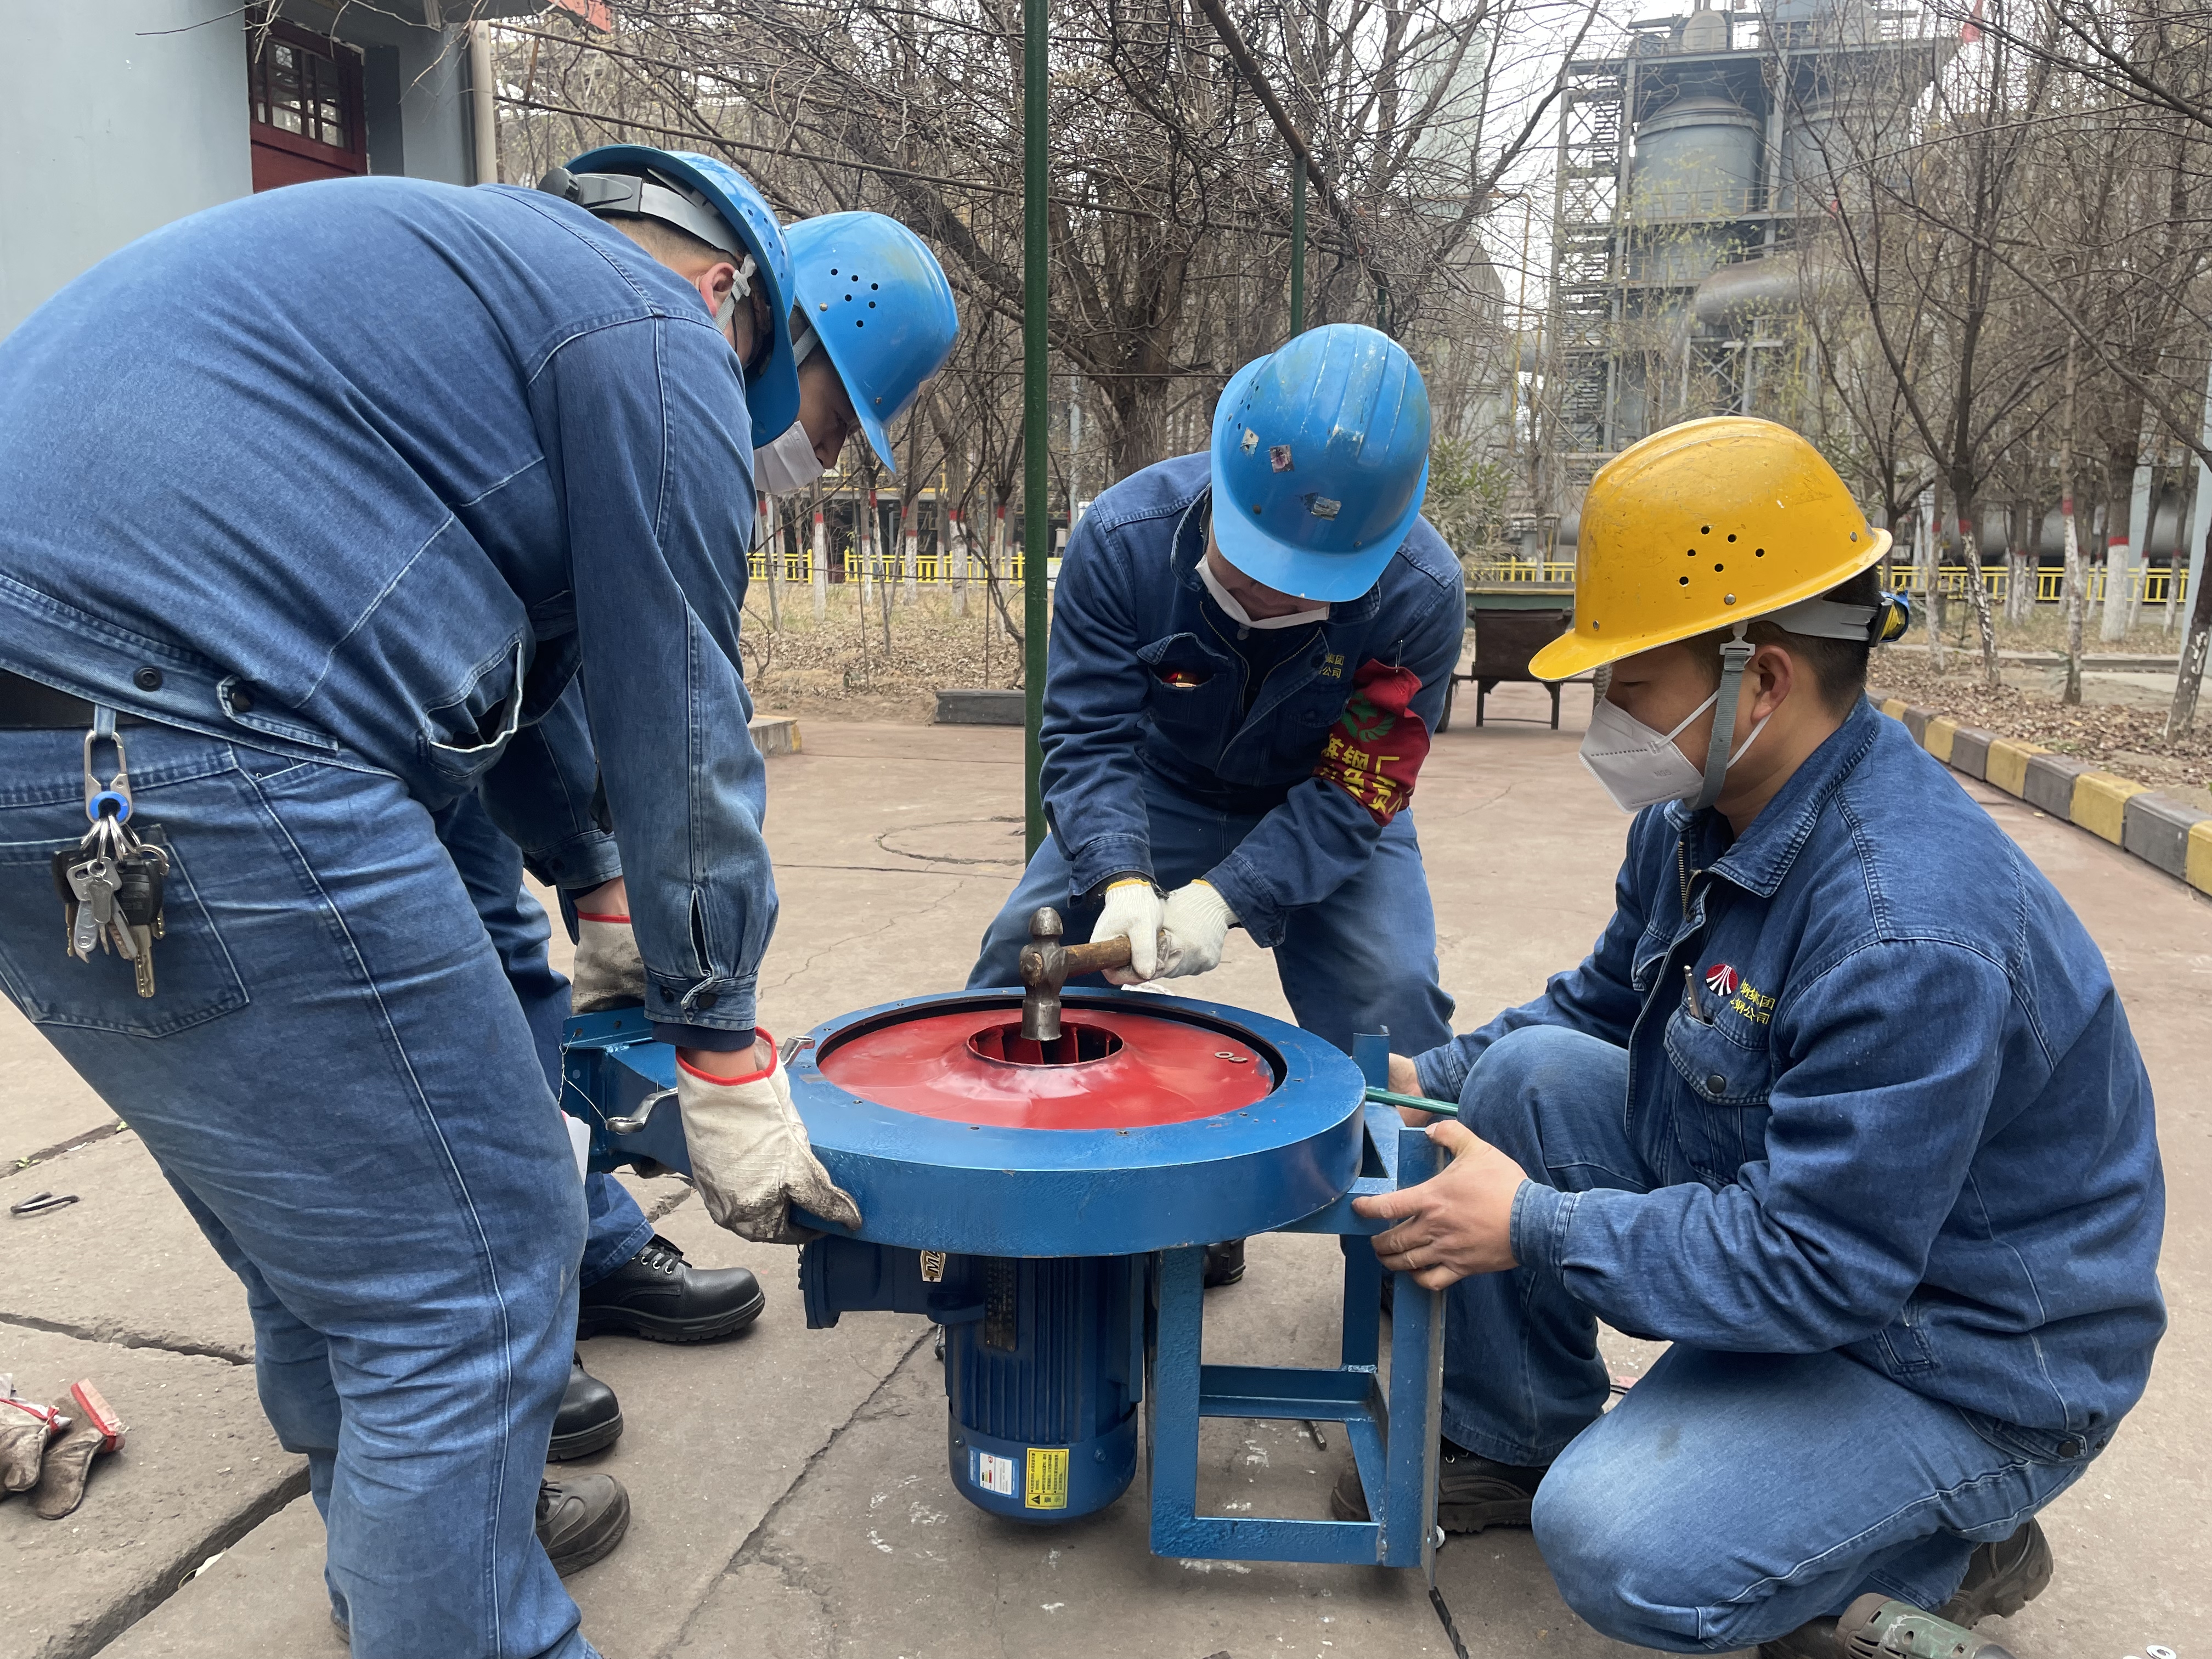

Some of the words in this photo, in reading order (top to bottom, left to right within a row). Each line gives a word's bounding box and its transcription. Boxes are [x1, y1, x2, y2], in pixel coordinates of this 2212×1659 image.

[1740, 978, 1776, 1010] 钢集团
[1730, 995, 1770, 1025] 钢公司
